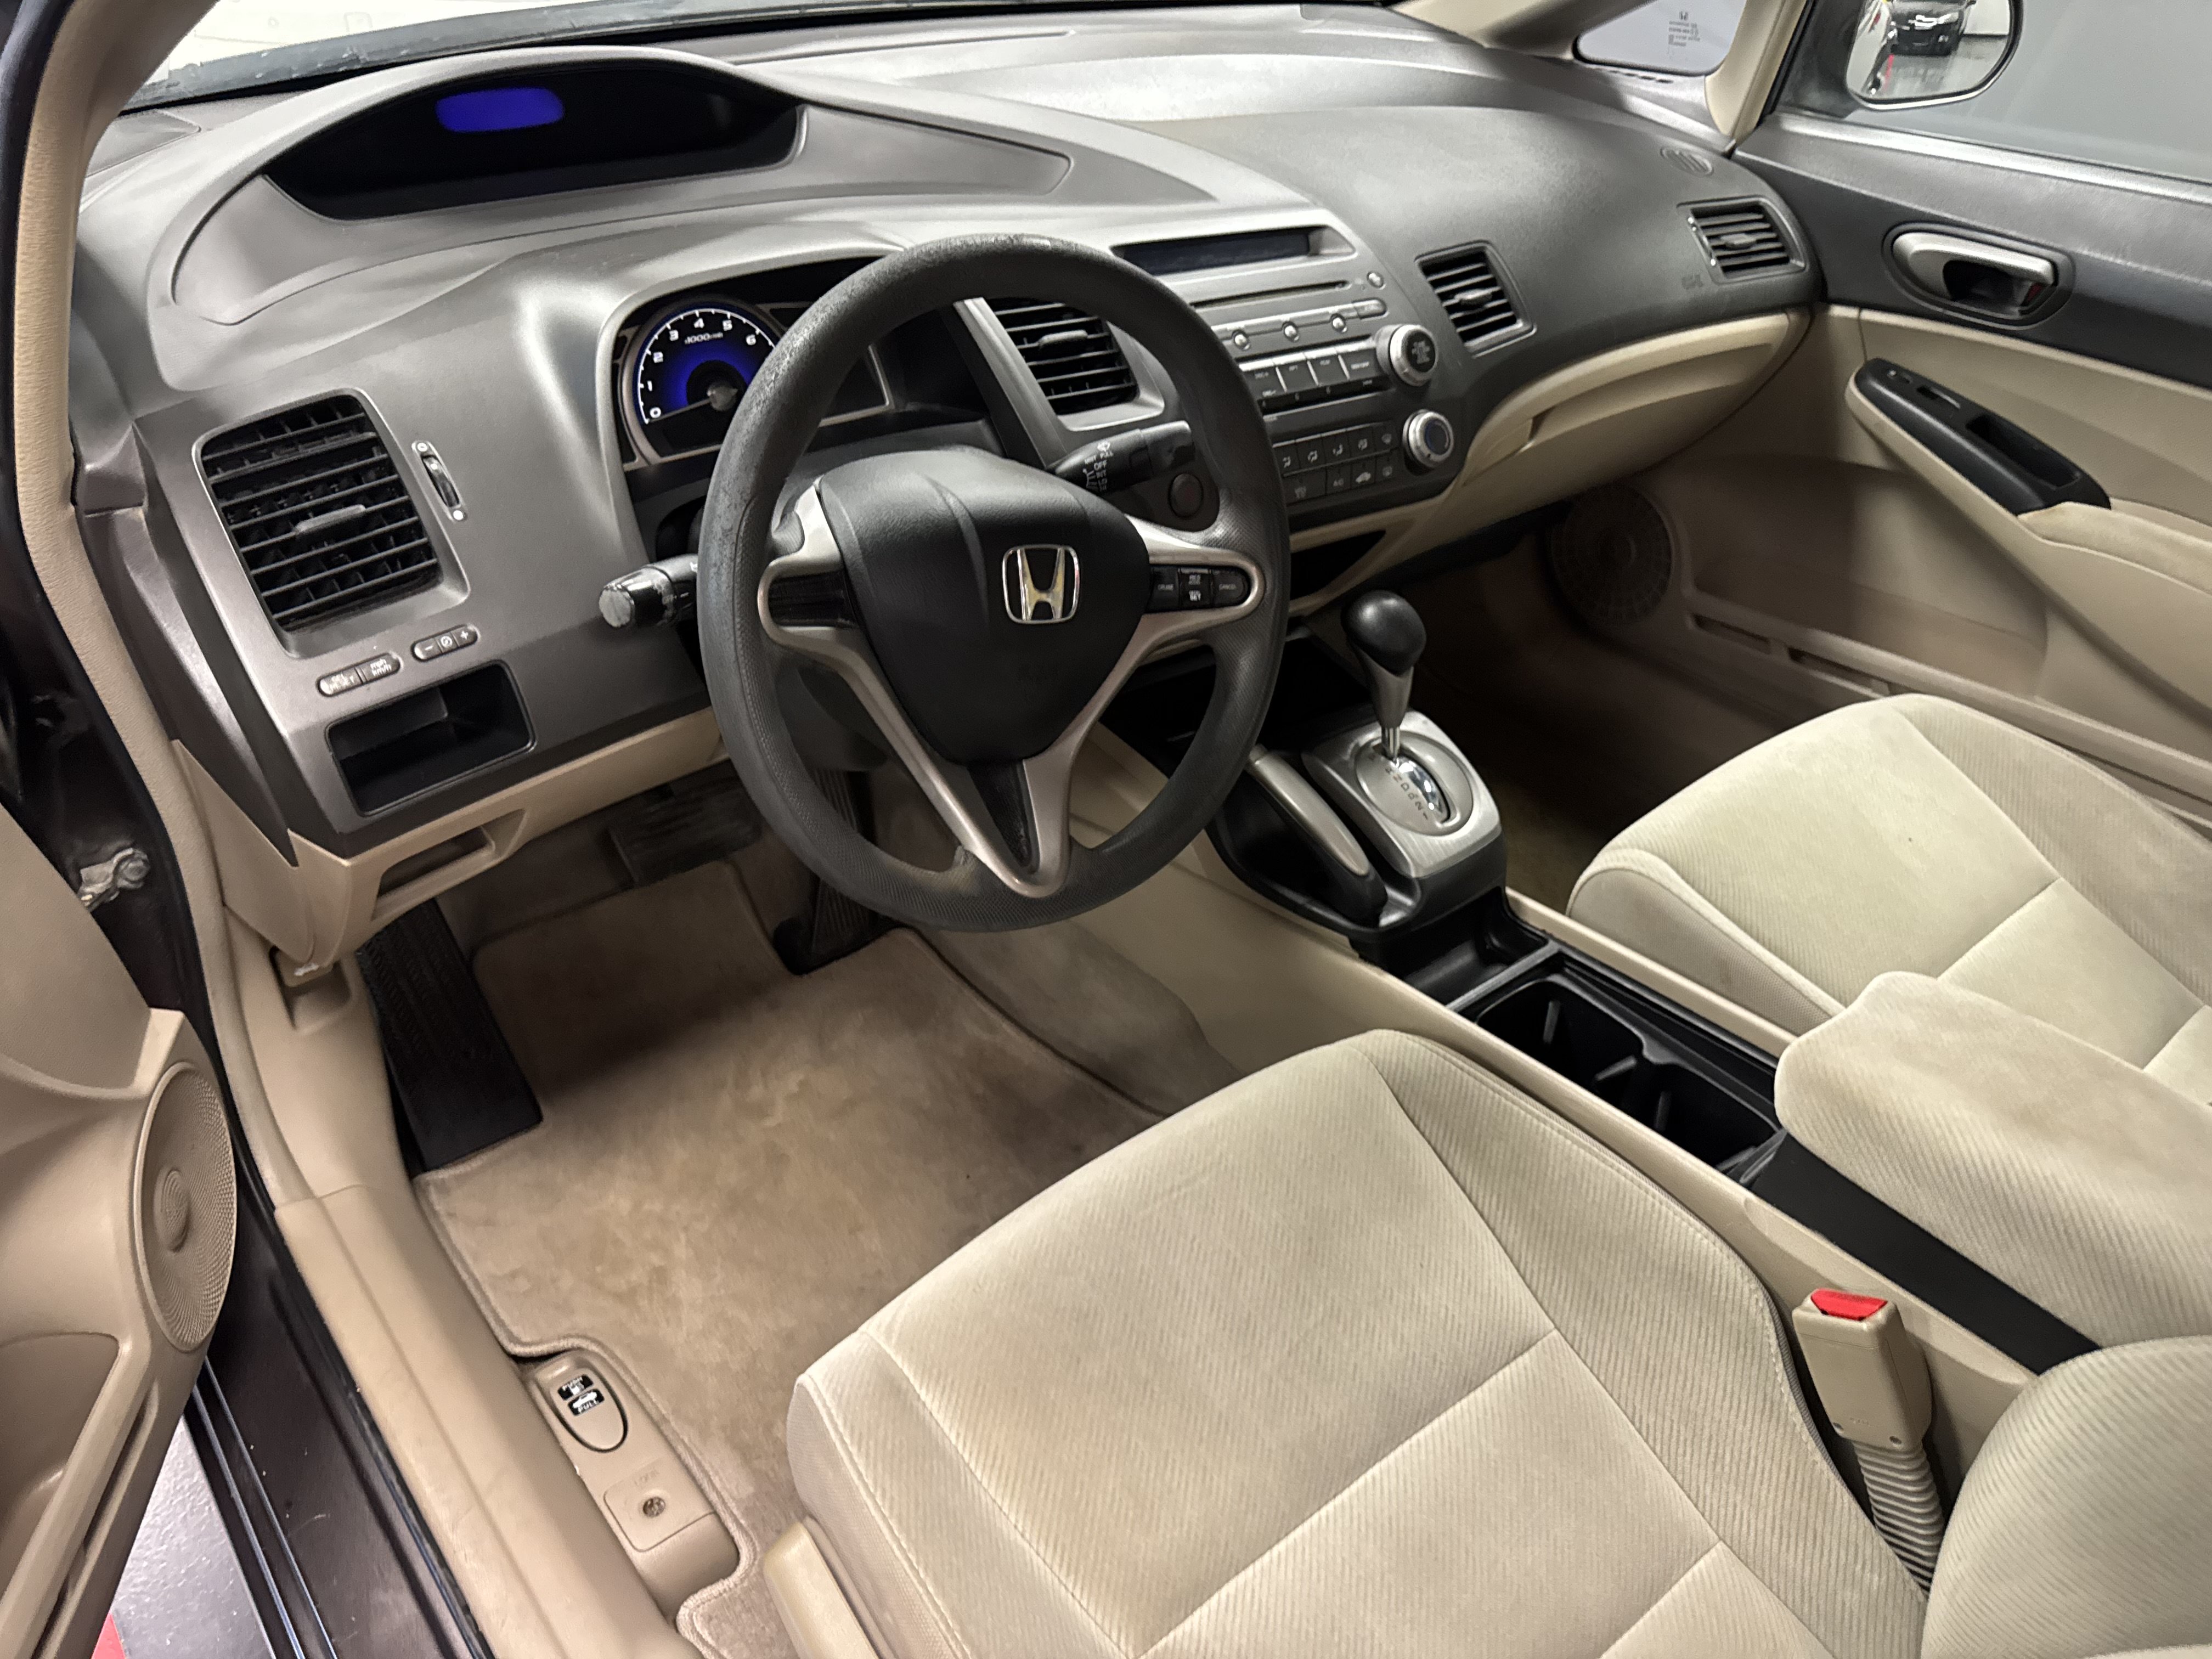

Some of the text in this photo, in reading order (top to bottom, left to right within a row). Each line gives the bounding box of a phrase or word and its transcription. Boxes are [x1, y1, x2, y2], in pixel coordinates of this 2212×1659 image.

[693, 318, 704, 329] 4
[722, 319, 733, 331] 5
[669, 329, 679, 341] 3
[746, 334, 757, 346] 6
[653, 351, 664, 363] 2
[647, 380, 653, 392] 1
[650, 407, 662, 419] 0
[1093, 460, 1107, 471] OFF
[370, 658, 387, 669] mph
[1401, 782, 1409, 792] D
[1415, 801, 1423, 810] 2
